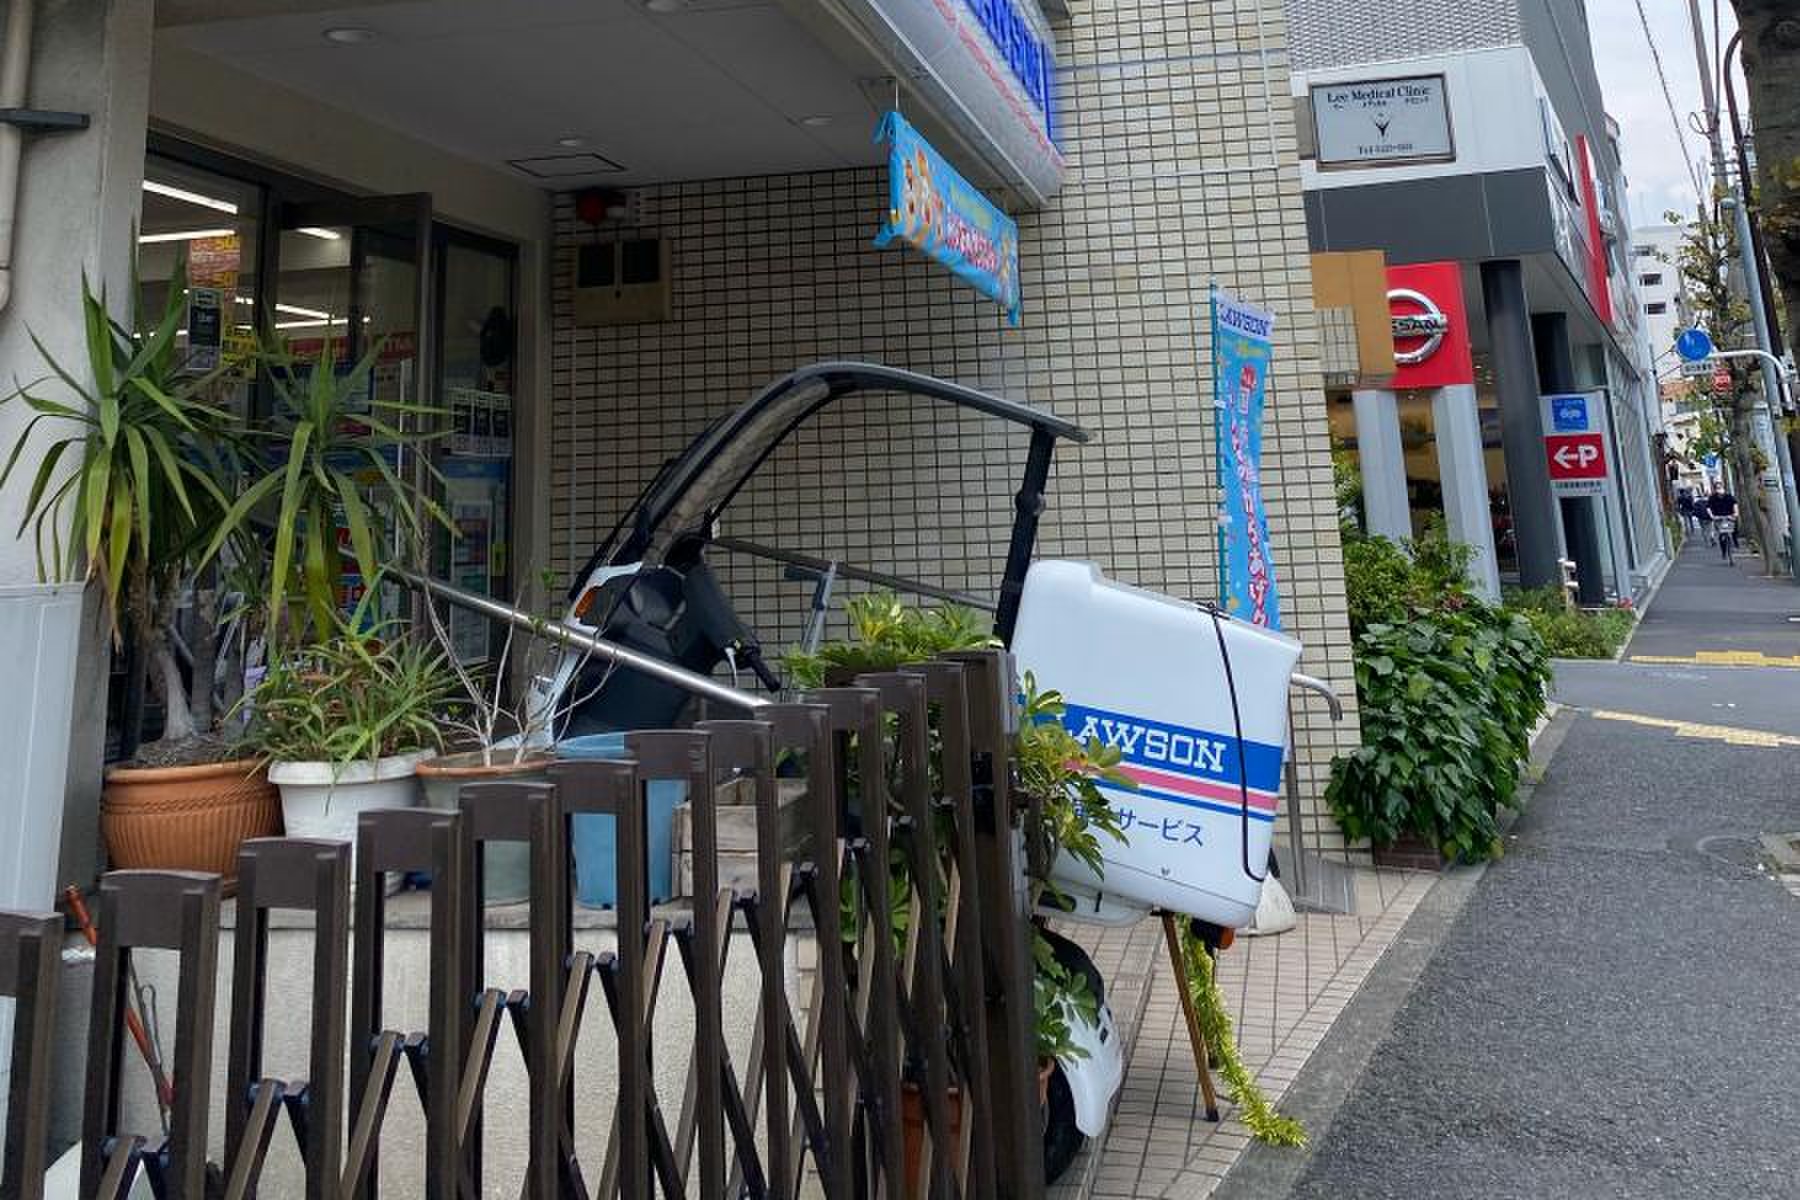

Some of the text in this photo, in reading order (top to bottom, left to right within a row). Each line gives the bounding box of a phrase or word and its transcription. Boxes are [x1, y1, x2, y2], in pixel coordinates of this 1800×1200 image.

[1351, 87, 1395, 100] Medical
[1397, 85, 1431, 97] Clinic
[1578, 445, 1599, 468] P
